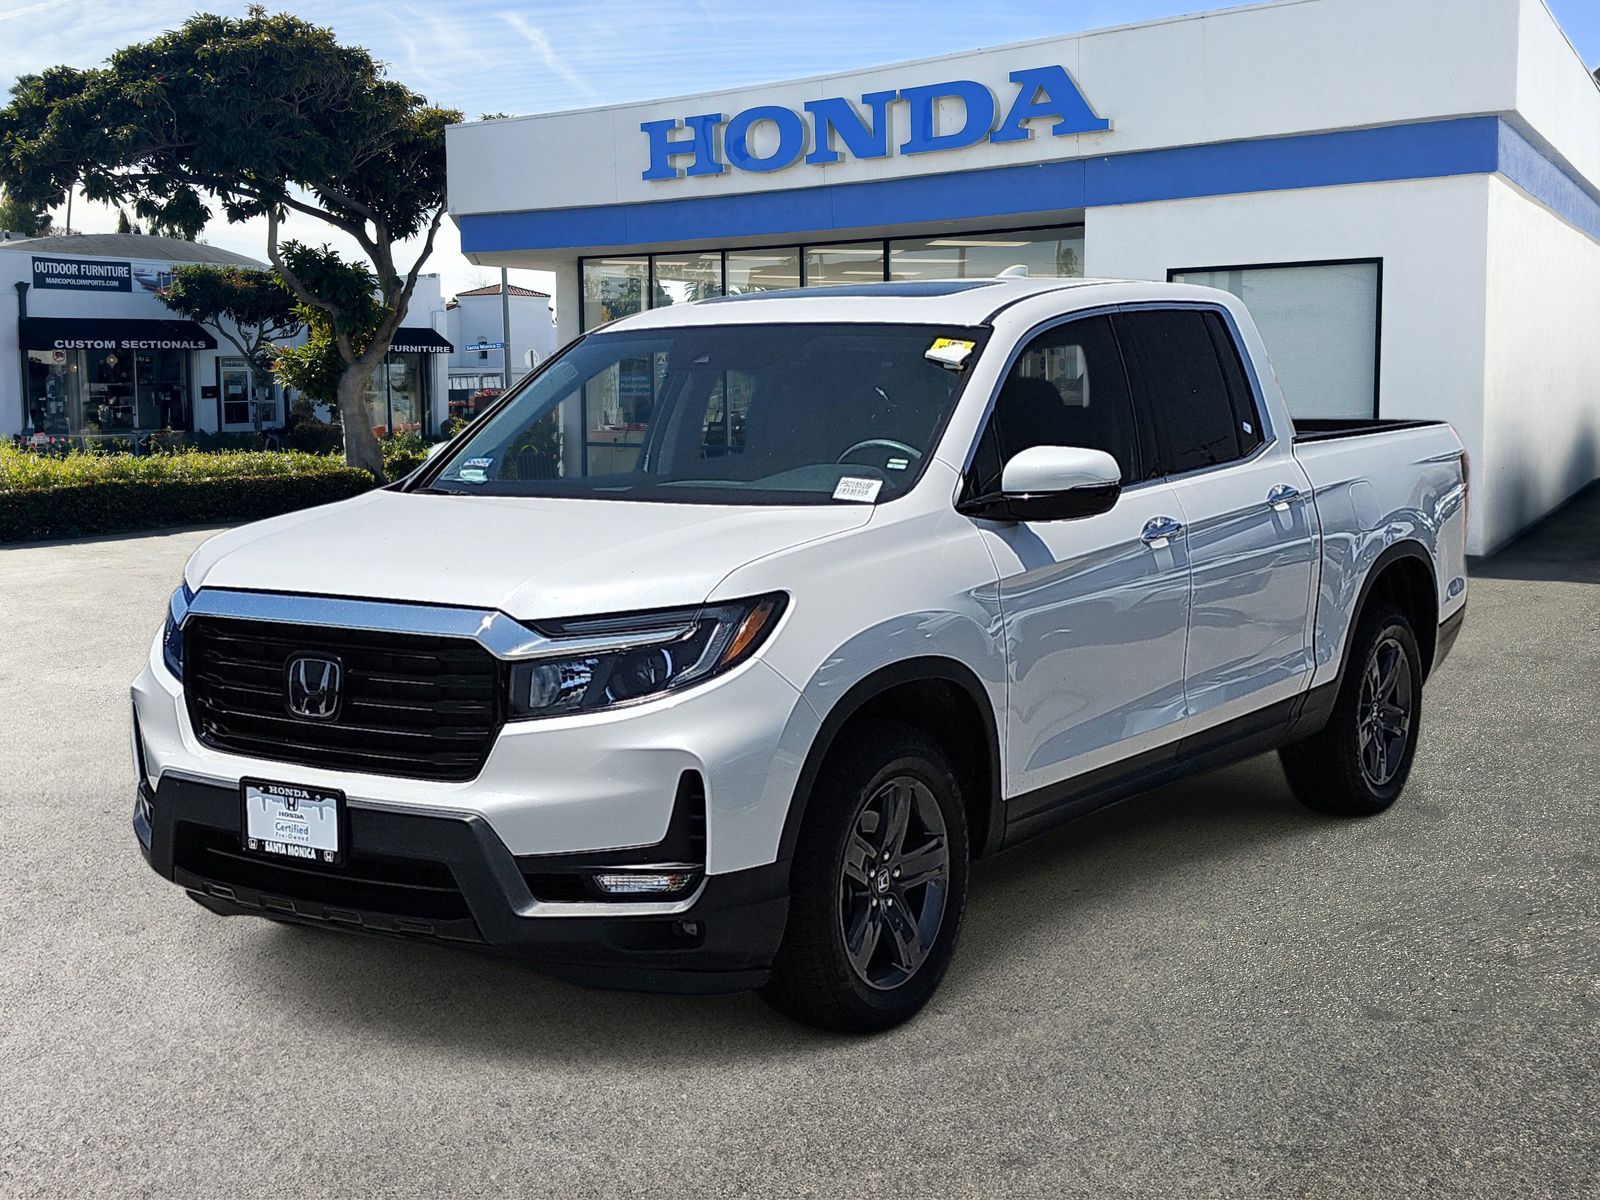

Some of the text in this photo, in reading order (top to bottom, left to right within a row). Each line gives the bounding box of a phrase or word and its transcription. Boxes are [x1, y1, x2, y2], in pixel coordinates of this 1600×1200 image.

[640, 65, 1111, 181] HONDA
[34, 261, 130, 278] OUTDOOR FURNITURE
[45, 277, 119, 287] MARCOPOLOIMPORTS.COM
[54, 339, 206, 349] CUSTOM SECTIONALS
[388, 344, 451, 353] FURNITURE
[268, 785, 310, 799] HONDA
[278, 810, 305, 820] HONDA
[275, 821, 309, 835] Certified
[265, 840, 317, 860] SANTA MONICA
